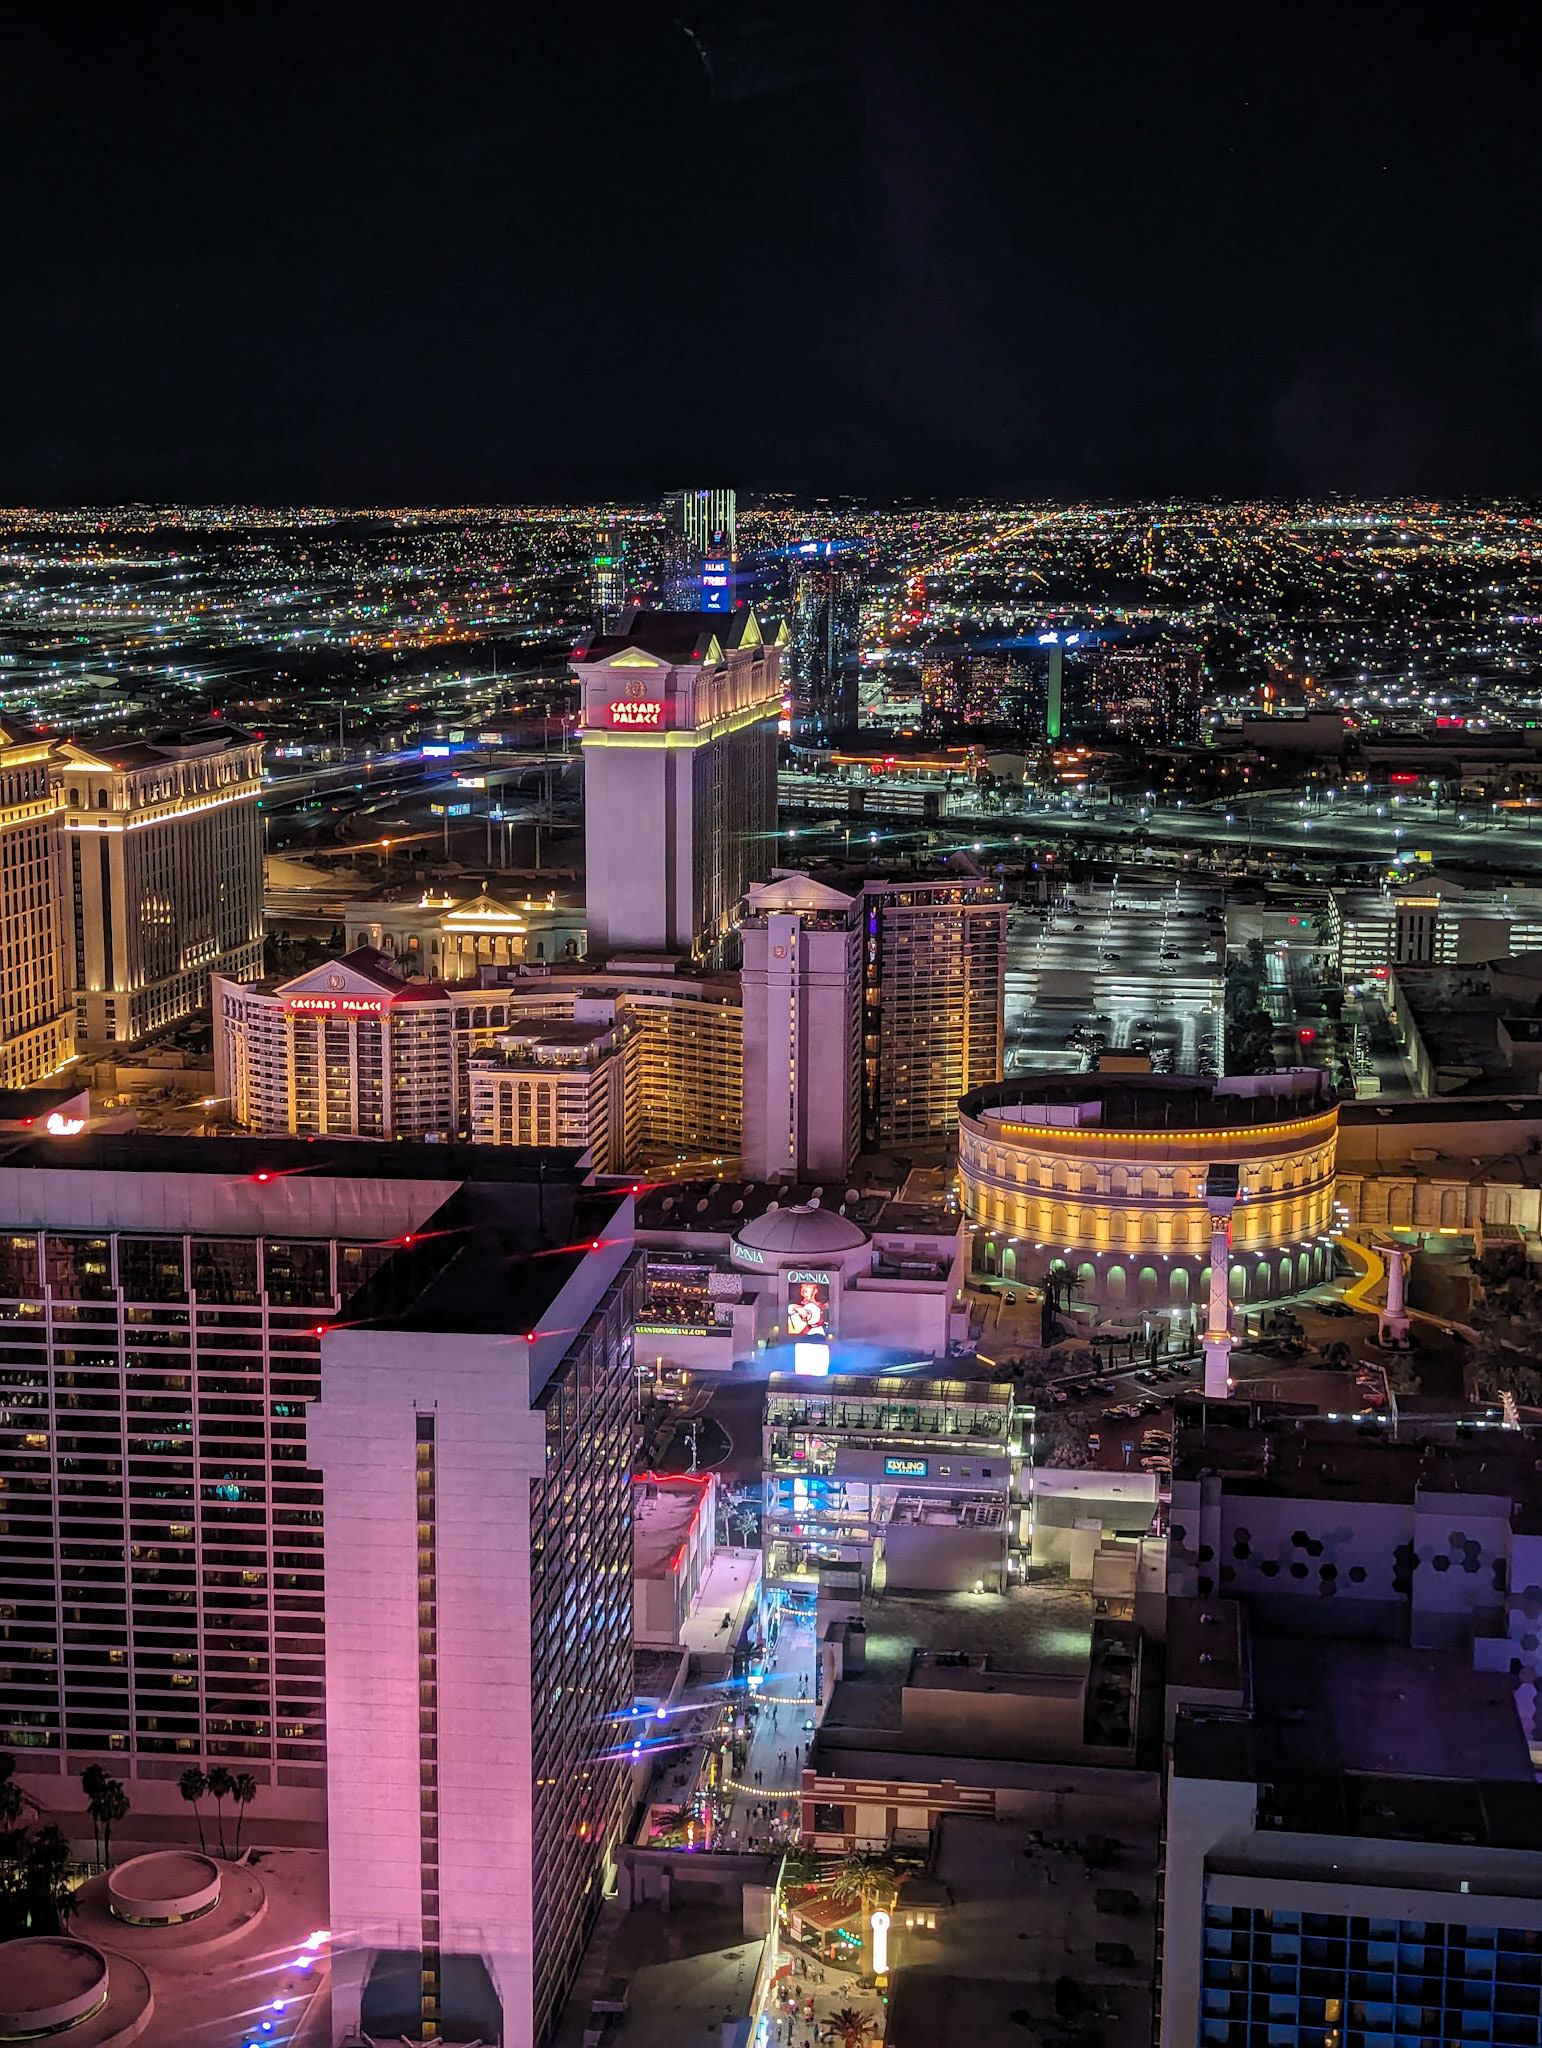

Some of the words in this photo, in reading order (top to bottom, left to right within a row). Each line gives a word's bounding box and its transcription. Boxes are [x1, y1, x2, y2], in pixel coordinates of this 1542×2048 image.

[705, 563, 724, 571] PALMS
[610, 702, 661, 713] CAESARS
[613, 713, 658, 724] PALACE
[290, 999, 337, 1009] CAESARS
[342, 1001, 381, 1011] PALACE
[733, 1242, 764, 1264] OMNIA
[787, 1270, 830, 1284] OMNIA
